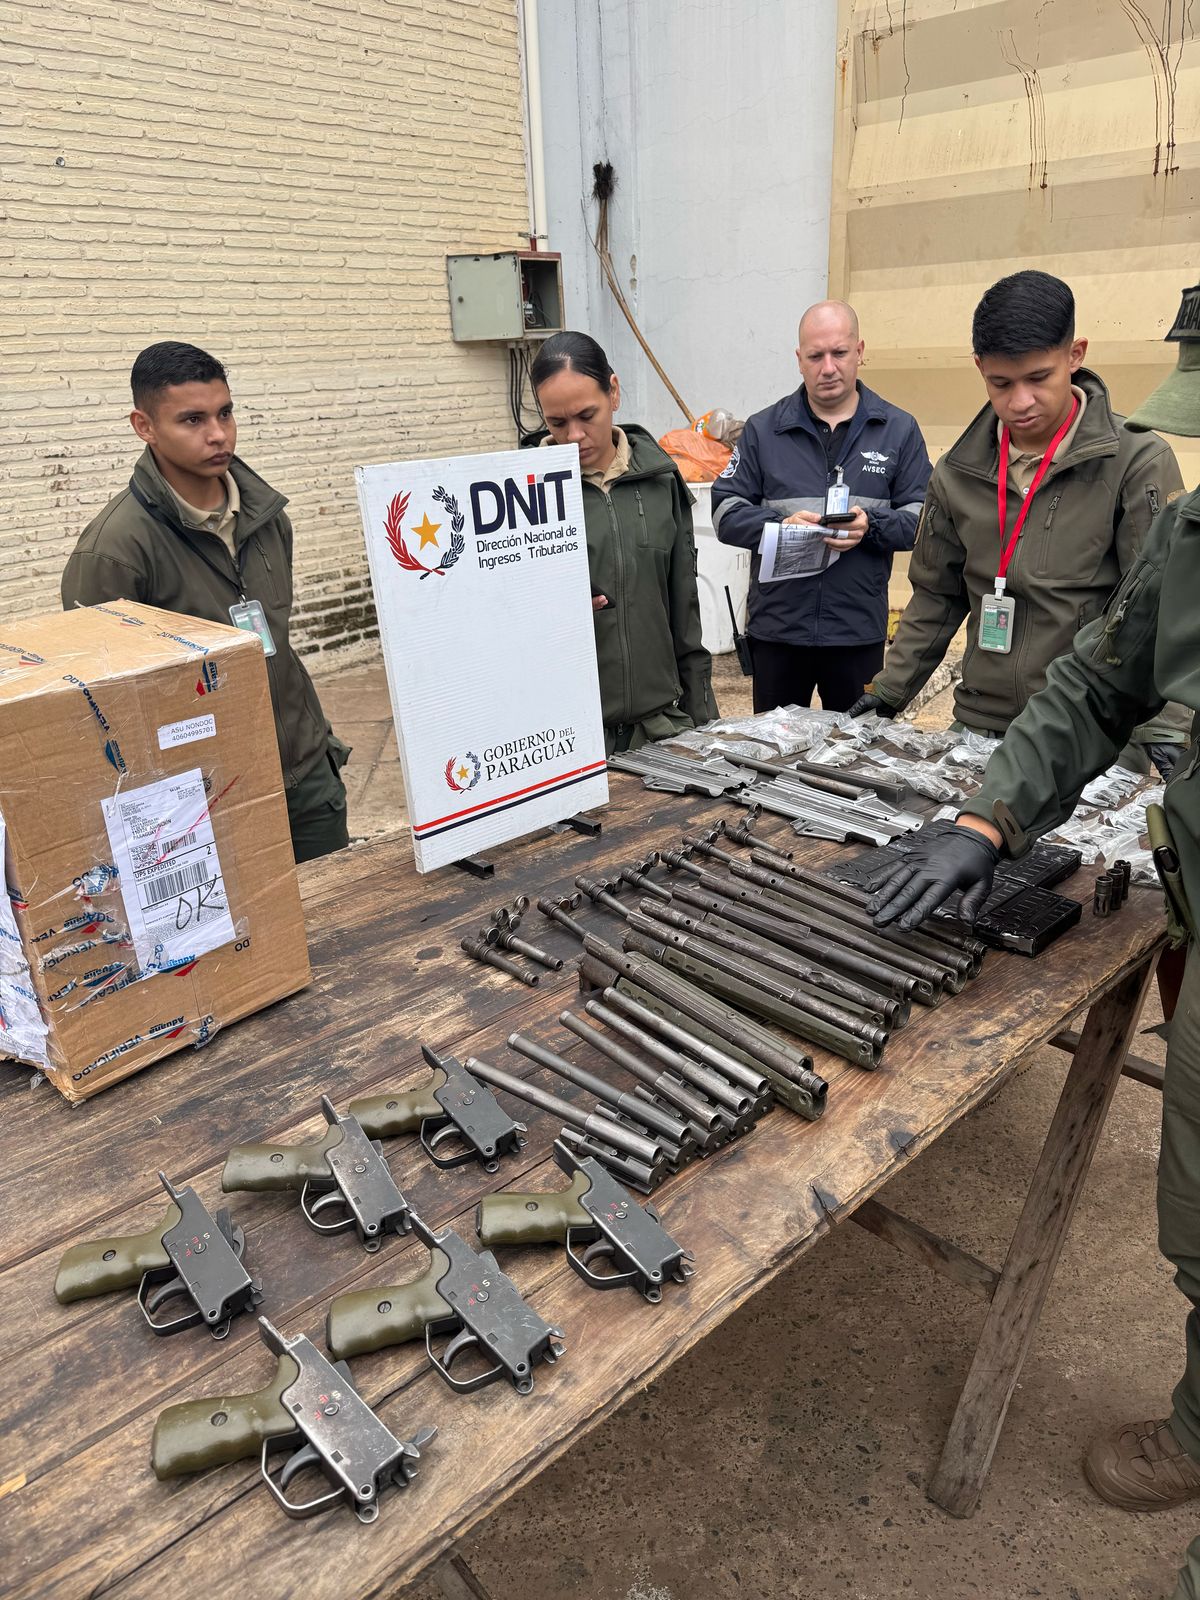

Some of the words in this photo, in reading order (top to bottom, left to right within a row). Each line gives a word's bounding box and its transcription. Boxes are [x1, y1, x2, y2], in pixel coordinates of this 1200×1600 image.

[861, 464, 886, 474] AVSEC
[476, 534, 522, 553] Dirección
[524, 526, 564, 545] Nacional
[565, 525, 577, 536] de
[478, 552, 522, 570] Ingresos
[527, 541, 579, 559] Tributarios
[171, 725, 184, 734] ASU
[185, 718, 213, 731] NONDOC
[483, 728, 556, 763] GOBIERNO
[559, 726, 575, 739] DEL
[485, 736, 576, 781] PARAGUAY
[207, 846, 212, 855] 2
[134, 870, 148, 879] UPS
[147, 860, 177, 875] EXPEDITED
[149, 1016, 185, 1034] Aduana
[72, 1034, 144, 1081] VERIFICADO
